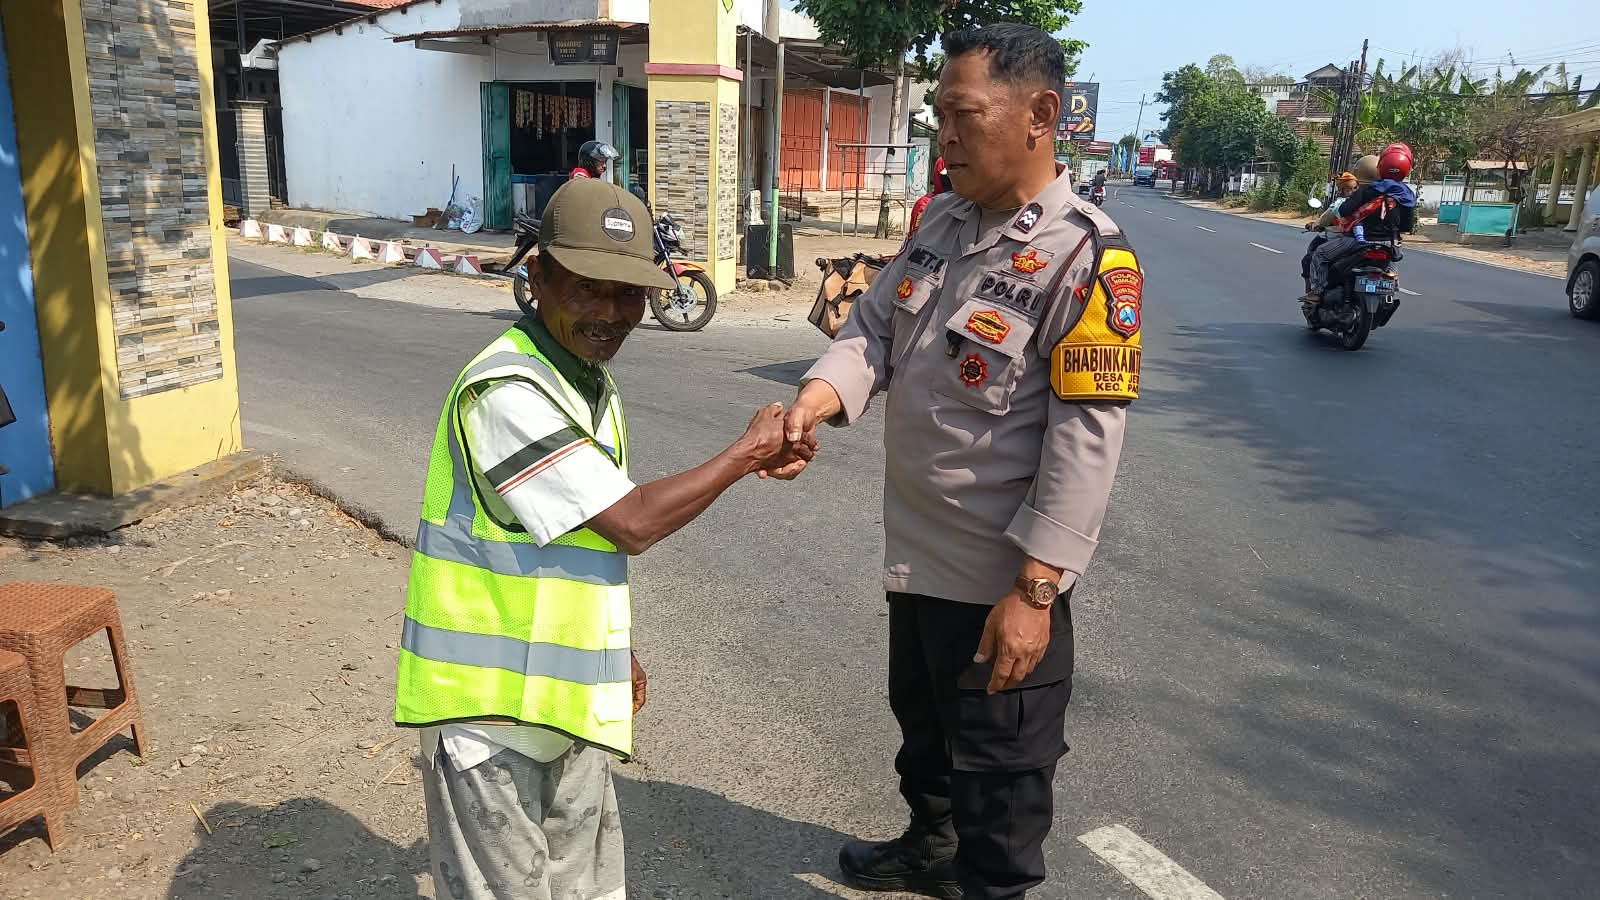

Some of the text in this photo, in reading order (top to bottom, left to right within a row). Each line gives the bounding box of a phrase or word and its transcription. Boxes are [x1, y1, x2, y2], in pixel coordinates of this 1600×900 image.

[981, 276, 1041, 311] POLRI
[1093, 372, 1124, 383] DESA
[1095, 382, 1123, 392] KEC.
